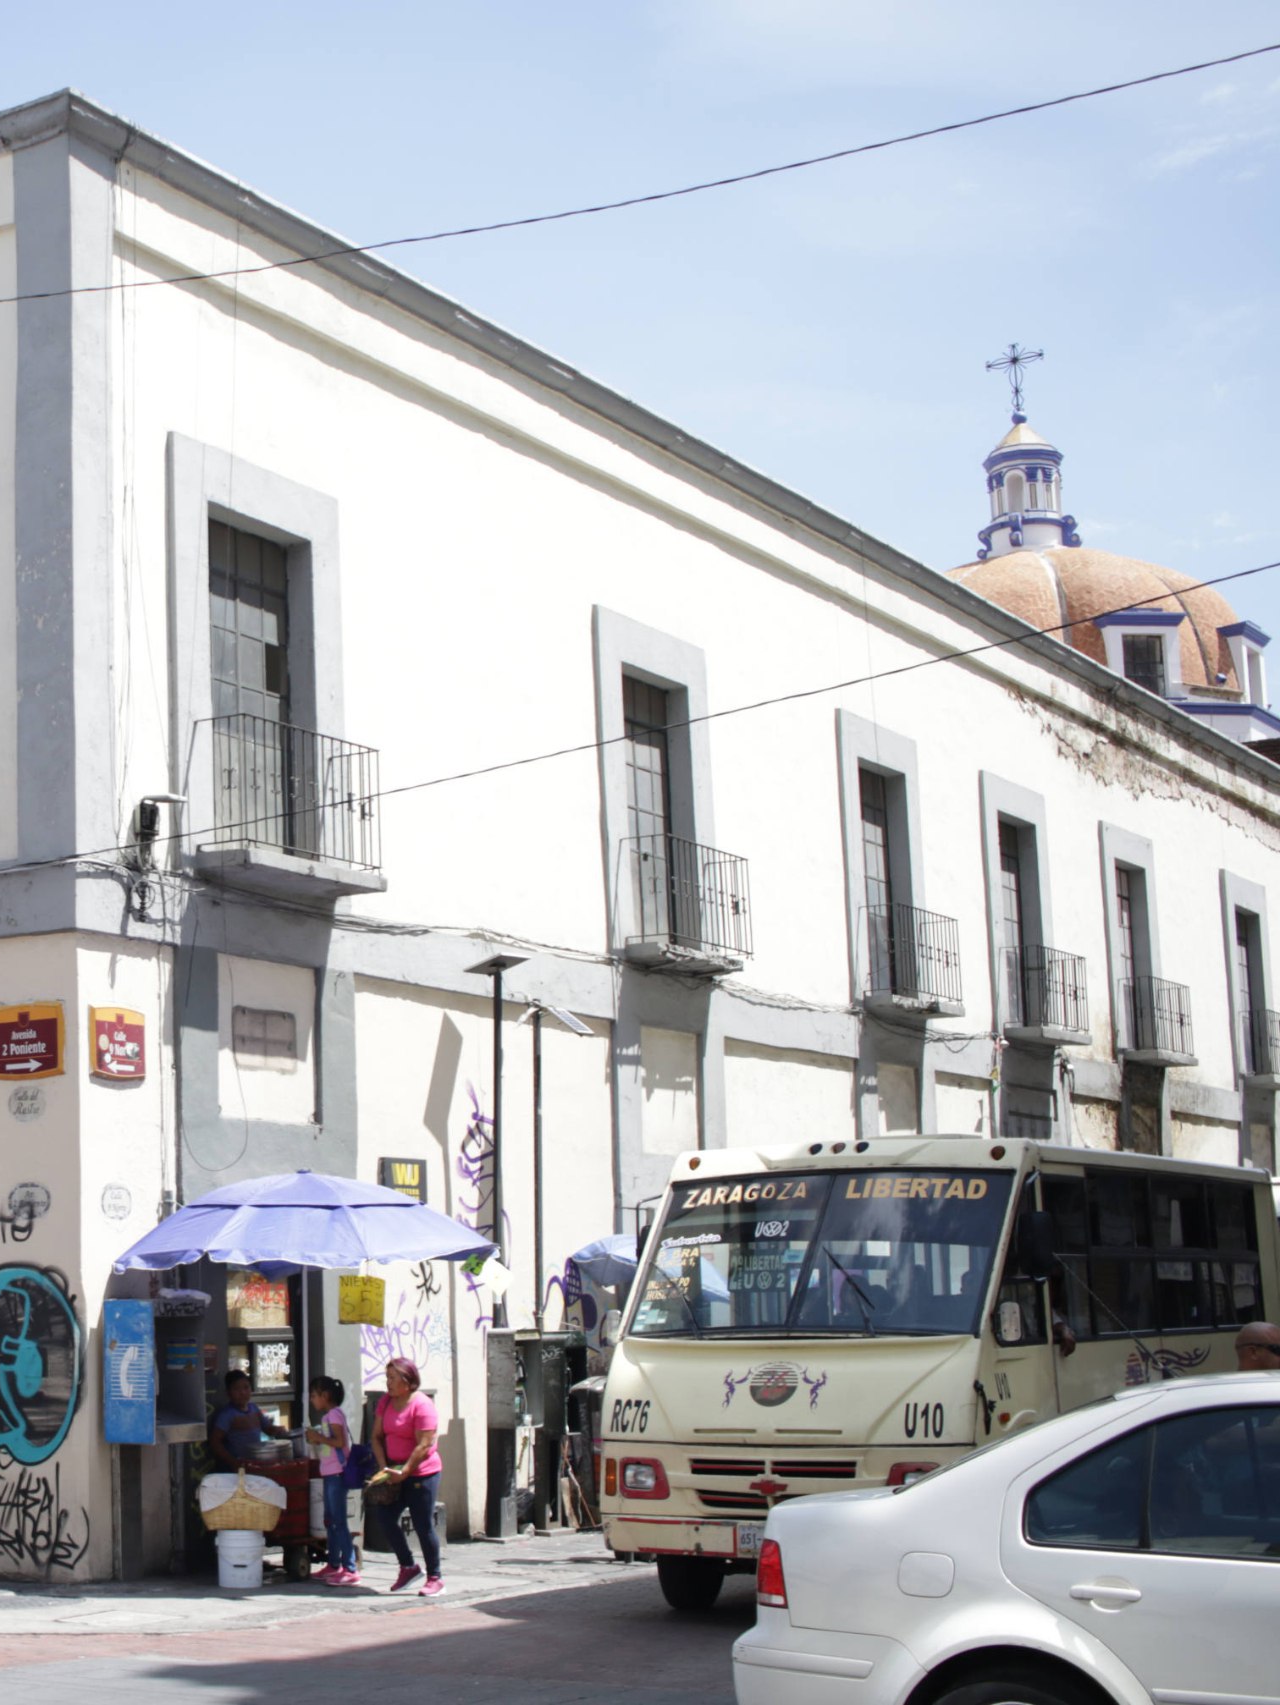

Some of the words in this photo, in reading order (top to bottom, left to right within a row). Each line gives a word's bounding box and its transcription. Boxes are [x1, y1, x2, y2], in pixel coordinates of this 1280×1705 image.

[10, 1028, 37, 1041] Avenida
[113, 1031, 127, 1042] Calle
[2, 1044, 8, 1056] 2
[10, 1042, 47, 1056] Poniente
[109, 1044, 114, 1055] 9
[682, 1181, 809, 1210] ZARAGOZA
[845, 1177, 988, 1200] LIBERTAD
[340, 1275, 382, 1289] NIEVES
[610, 1398, 651, 1433] RC76
[904, 1402, 944, 1439] U10
